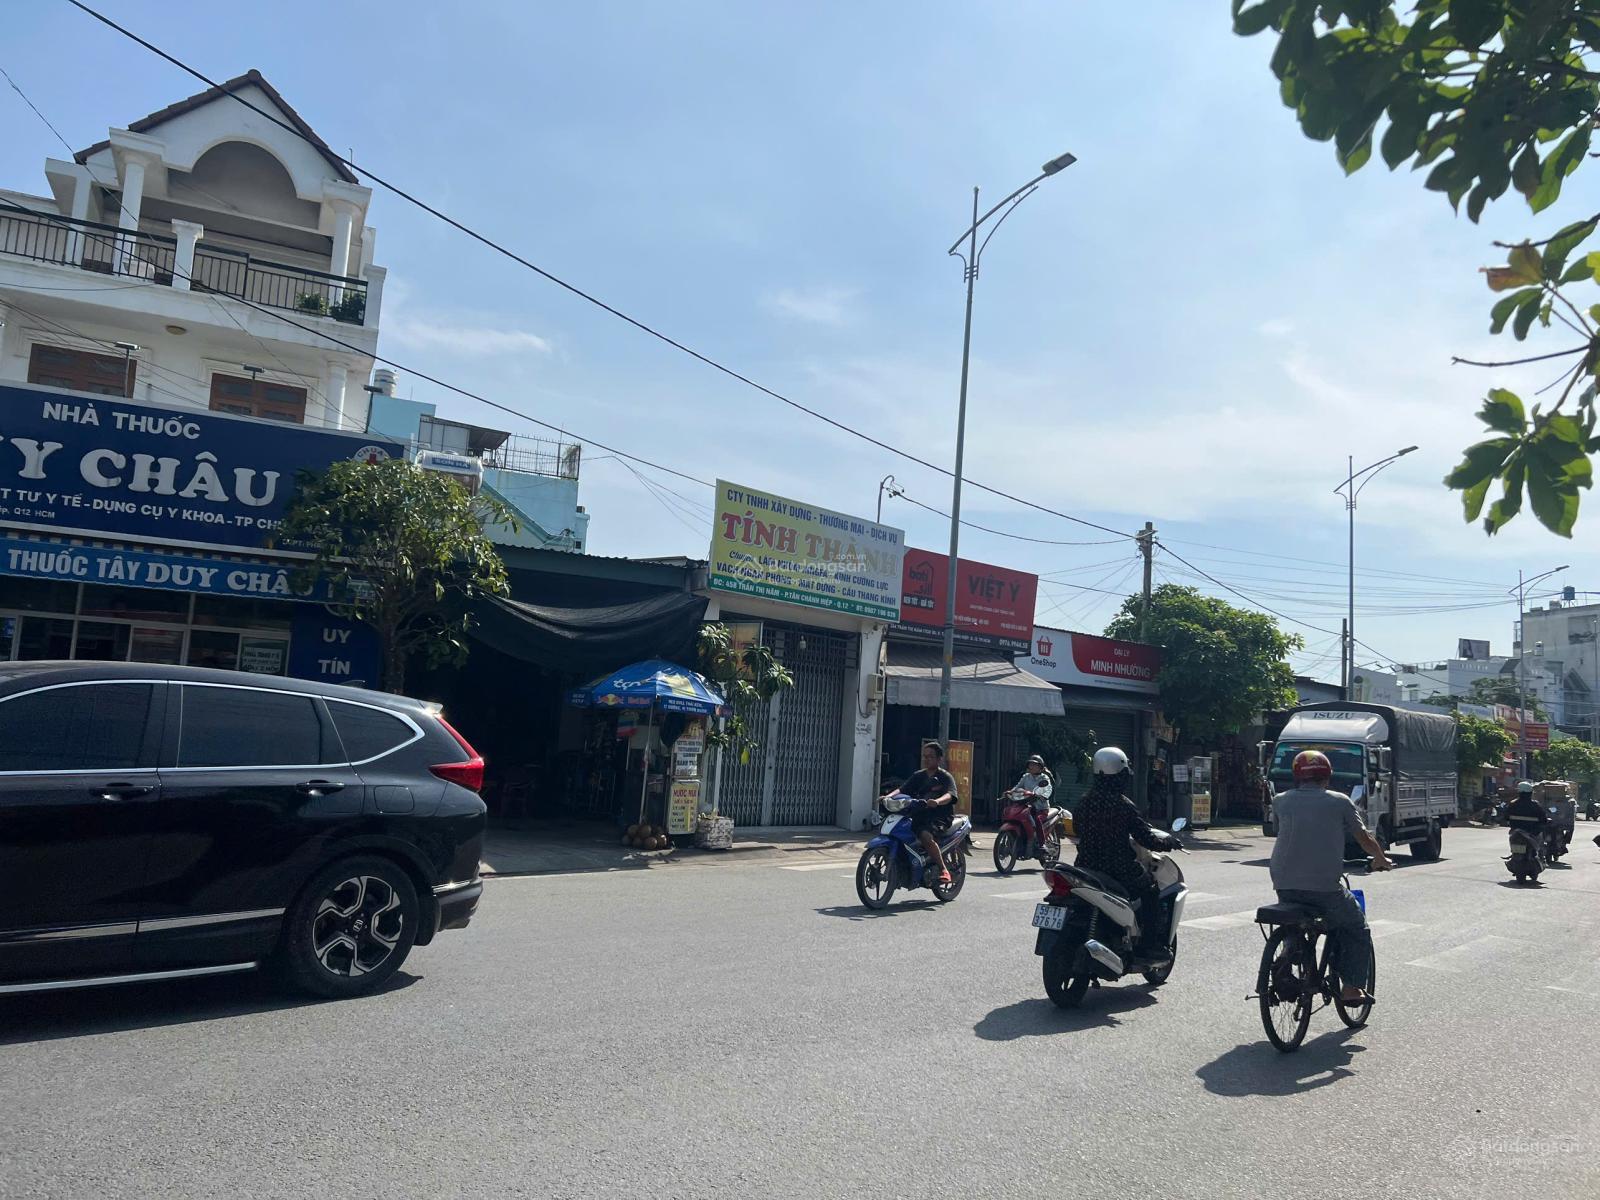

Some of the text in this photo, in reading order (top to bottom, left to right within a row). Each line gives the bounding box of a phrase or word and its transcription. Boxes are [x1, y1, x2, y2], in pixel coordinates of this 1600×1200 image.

[42, 401, 201, 440] NHÀ THUỐC
[79, 451, 281, 507] CHÂU
[14, 507, 31, 516] Q12
[34, 509, 56, 519] HCM
[16, 489, 41, 503] TƯ
[45, 493, 57, 504] Y
[61, 492, 83, 508] TẾ
[92, 499, 137, 515] DỤNG
[140, 504, 163, 521] CỤ
[167, 507, 179, 519] Y
[182, 509, 225, 525] KHOA
[234, 515, 254, 527] TP
[727, 488, 744, 503] CTY
[746, 493, 769, 510] TNHH
[770, 498, 788, 515] XÂY
[850, 521, 865, 537] MẠI
[7, 547, 89, 576] THUỐC
[96, 555, 141, 581] TÂY
[144, 562, 219, 588] DUY
[857, 589, 880, 603] THANG
[322, 627, 352, 644] UY
[317, 656, 351, 675] TÍN
[1030, 656, 1058, 669] OneShop
[1090, 658, 1113, 673] MINH
[1312, 711, 1356, 720] ISUZU
